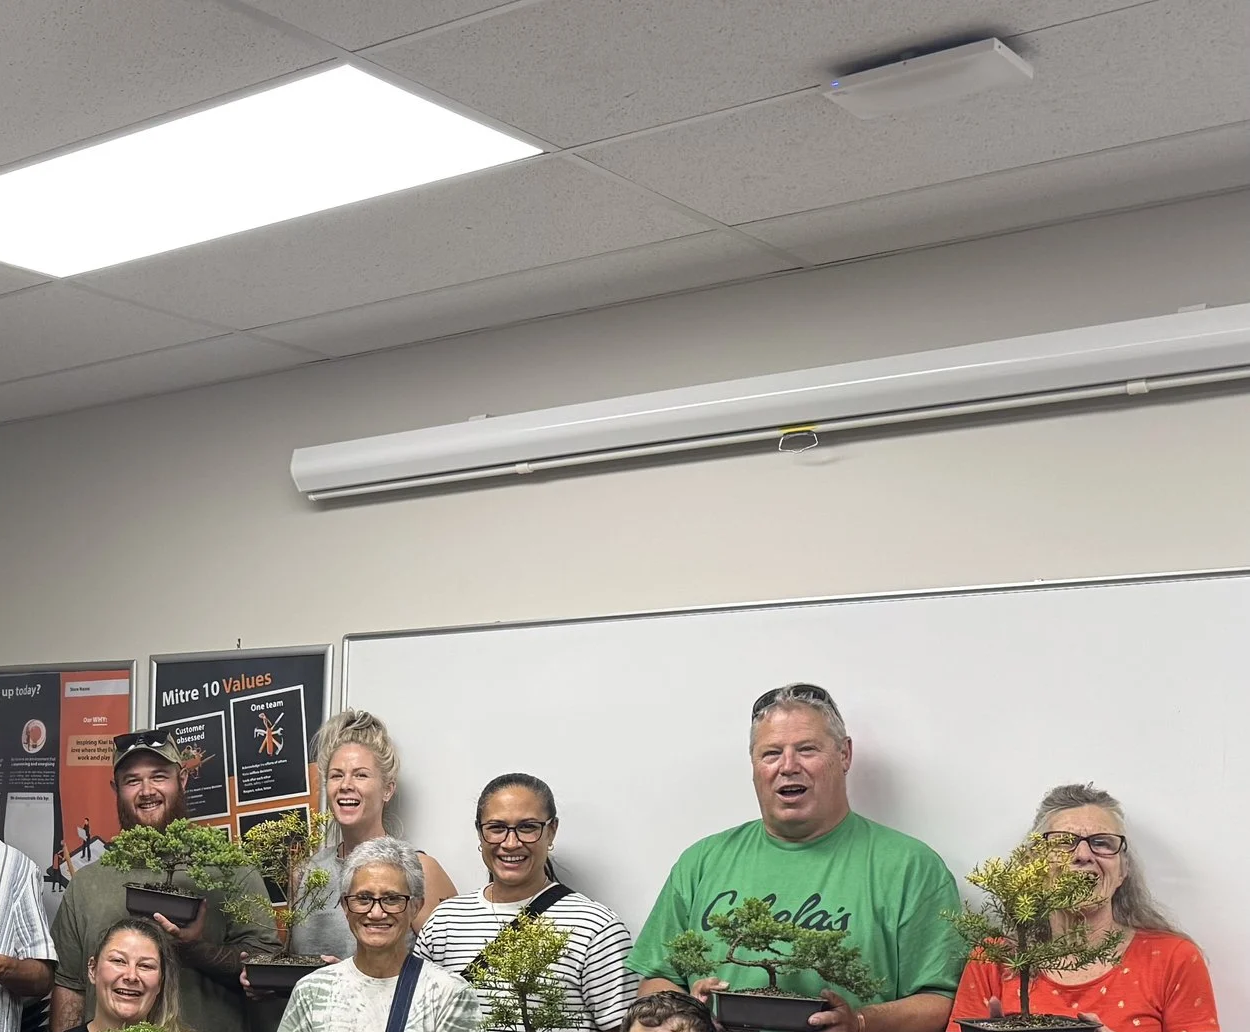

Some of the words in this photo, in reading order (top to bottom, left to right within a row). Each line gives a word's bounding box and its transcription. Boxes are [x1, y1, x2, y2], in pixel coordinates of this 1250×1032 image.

[2, 688, 14, 699] up
[15, 684, 41, 696] today?
[162, 687, 199, 707] Mitre
[202, 681, 220, 698] 10
[222, 672, 272, 693] Values
[250, 703, 265, 712] One
[266, 700, 283, 709] team
[175, 724, 205, 736] Customer
[177, 733, 205, 745] obsessed
